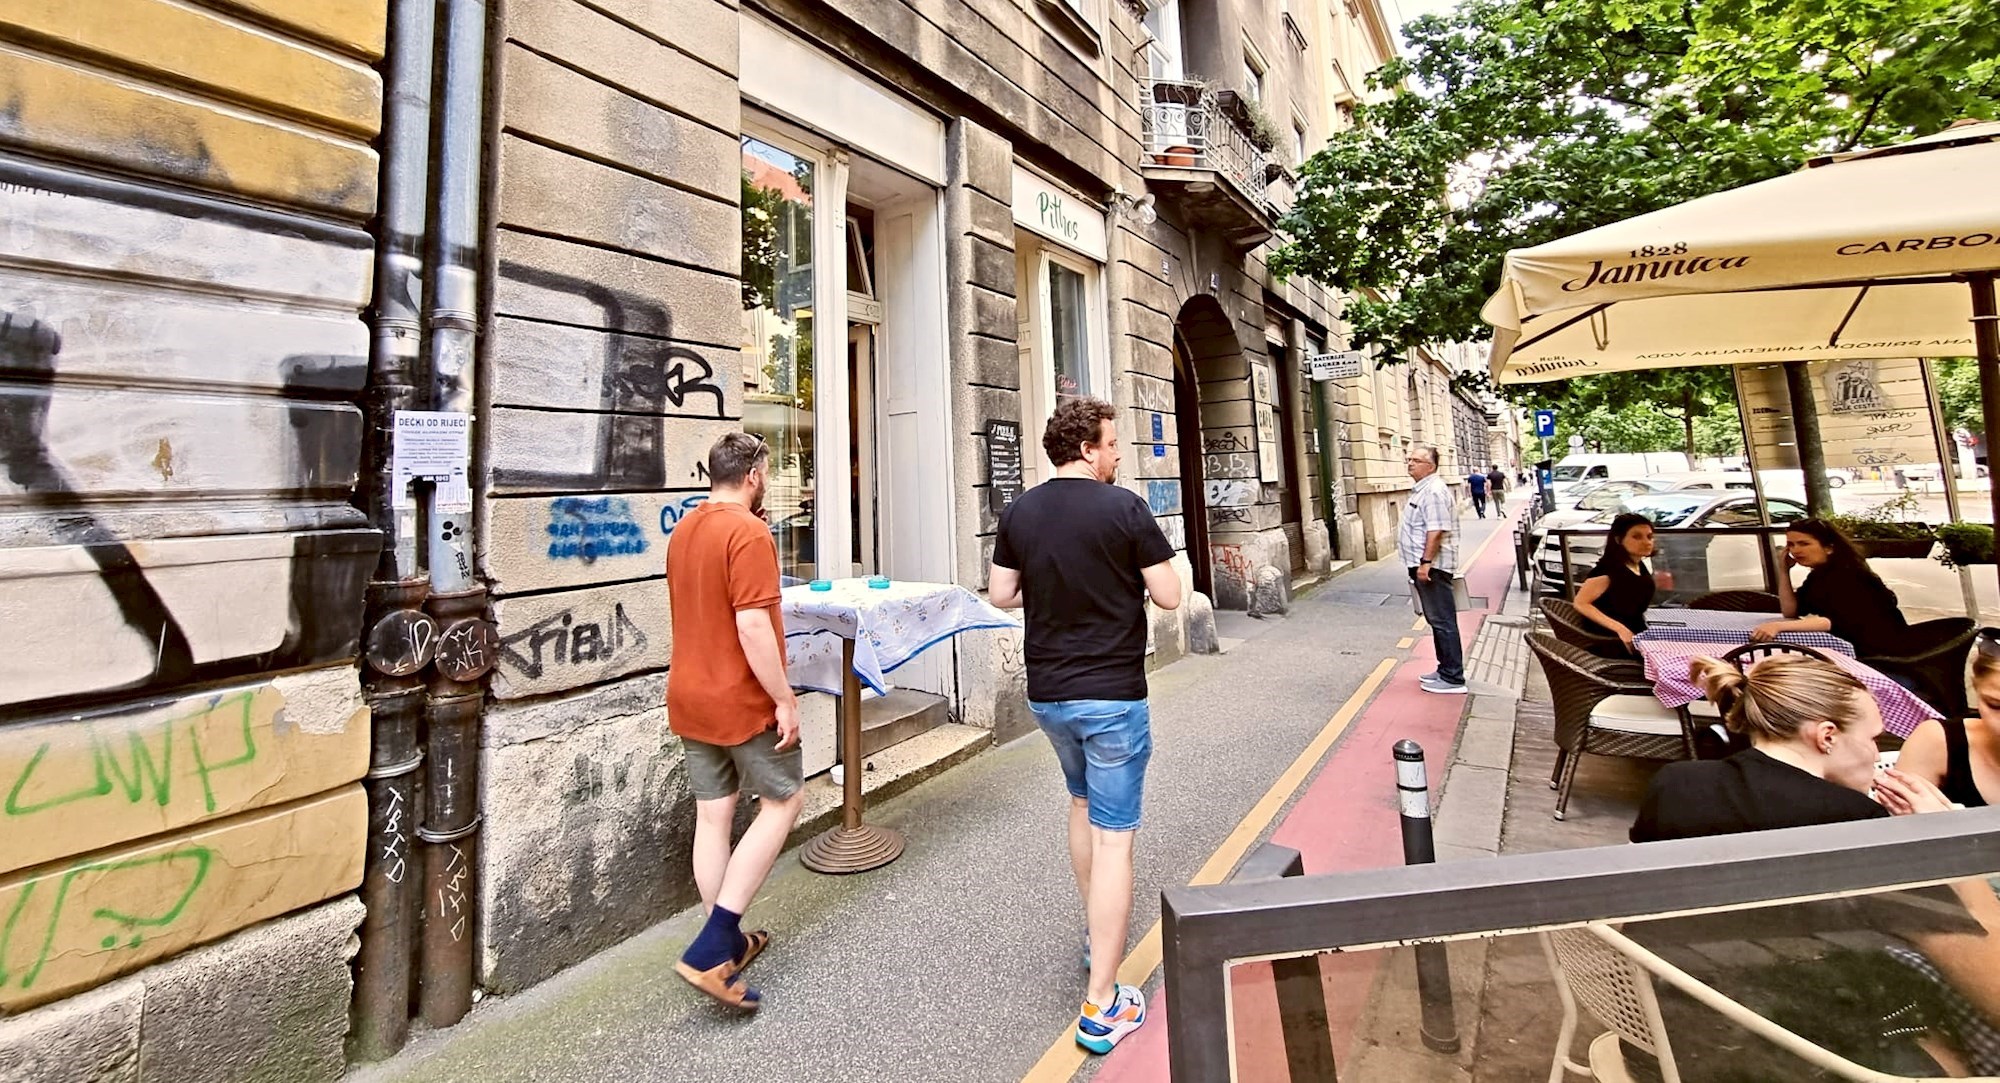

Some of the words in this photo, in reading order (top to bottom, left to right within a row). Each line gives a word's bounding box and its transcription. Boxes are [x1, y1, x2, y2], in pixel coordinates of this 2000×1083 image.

[1036, 191, 1079, 241] Pithos
[1629, 241, 1689, 258] 1828
[1836, 233, 2000, 256] CARBO
[1561, 255, 1752, 292] Jamnica
[399, 417, 424, 427] DEČKI
[426, 418, 438, 427] OD
[440, 417, 466, 427] RIJEČI
[1538, 414, 1551, 432] P
